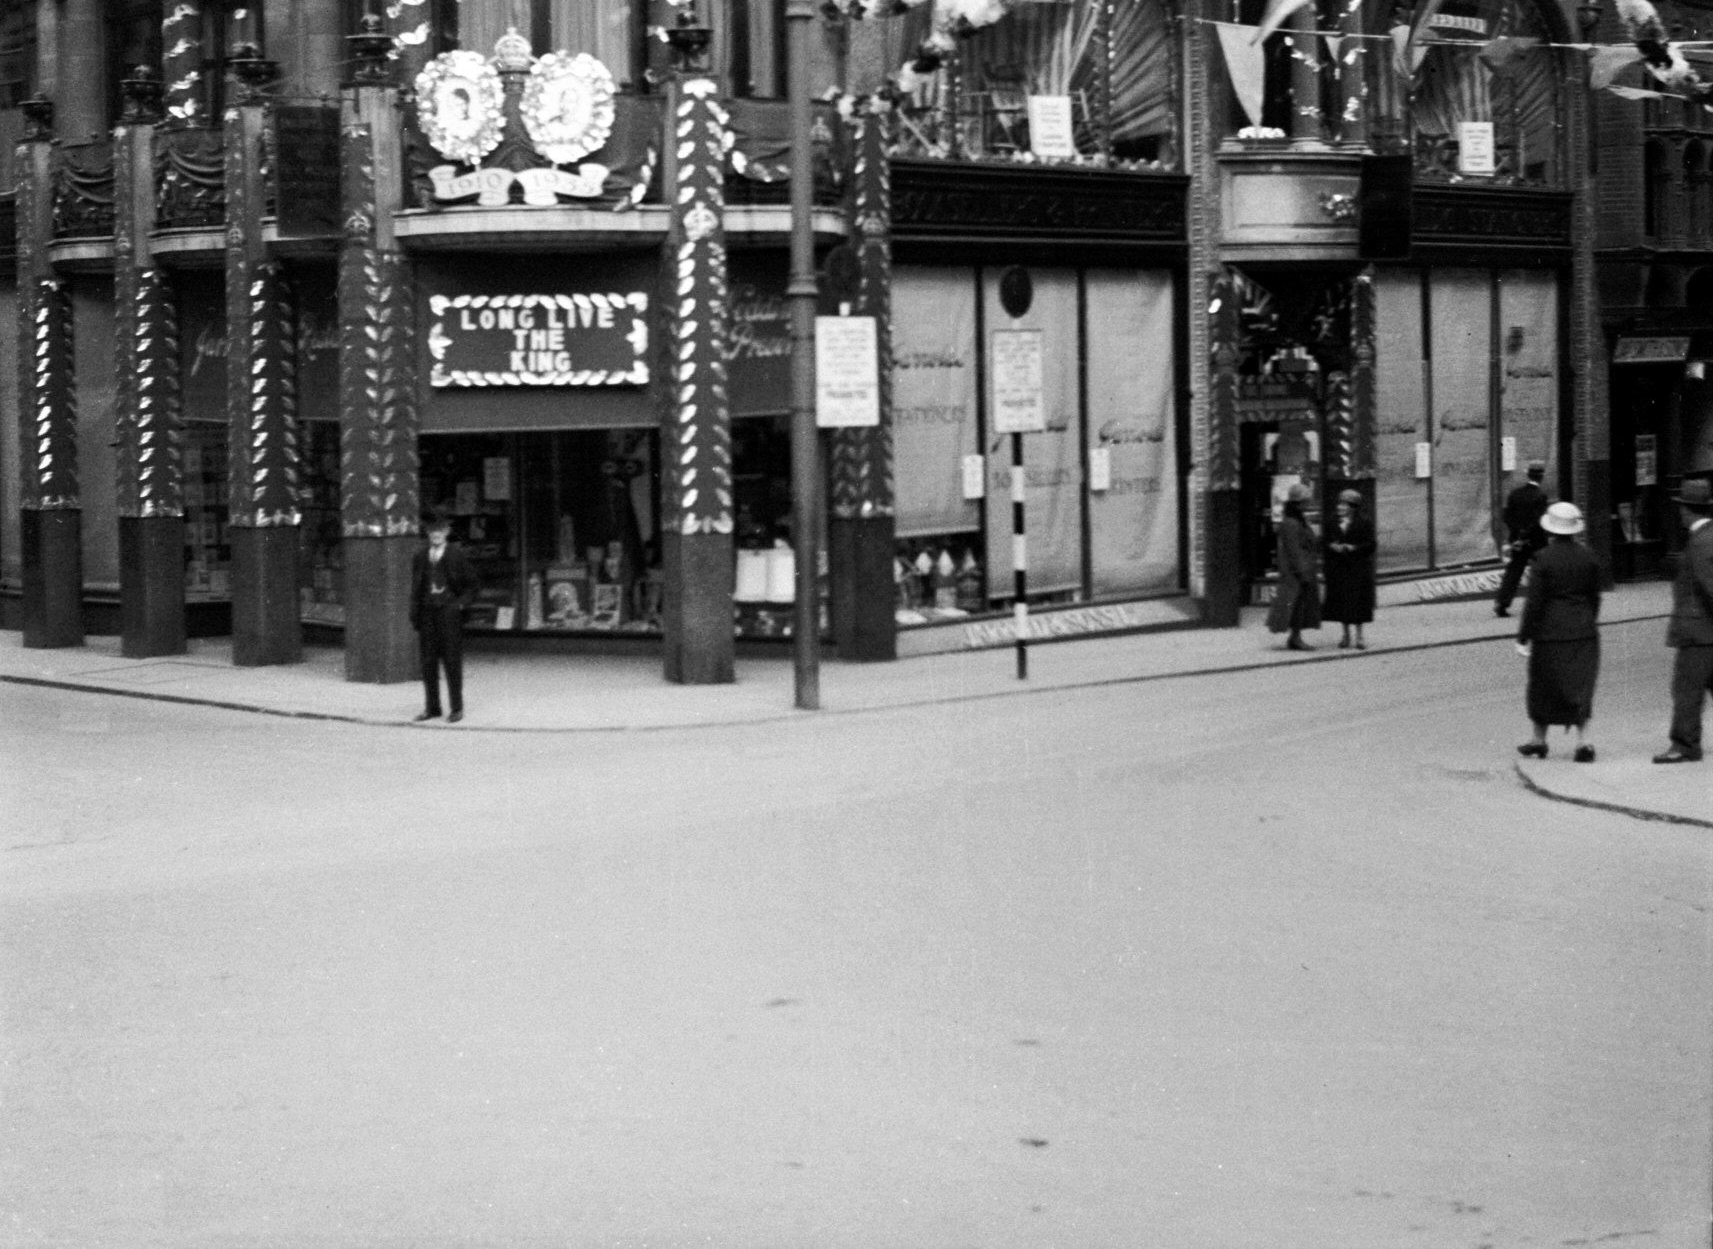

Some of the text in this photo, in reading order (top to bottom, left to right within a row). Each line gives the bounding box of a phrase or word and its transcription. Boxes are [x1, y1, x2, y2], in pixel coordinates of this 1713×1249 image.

[447, 172, 503, 196] 1910
[532, 171, 596, 196] 1935
[460, 306, 615, 331] LONG LIVE
[512, 328, 566, 351] THE
[509, 351, 572, 373] KING
